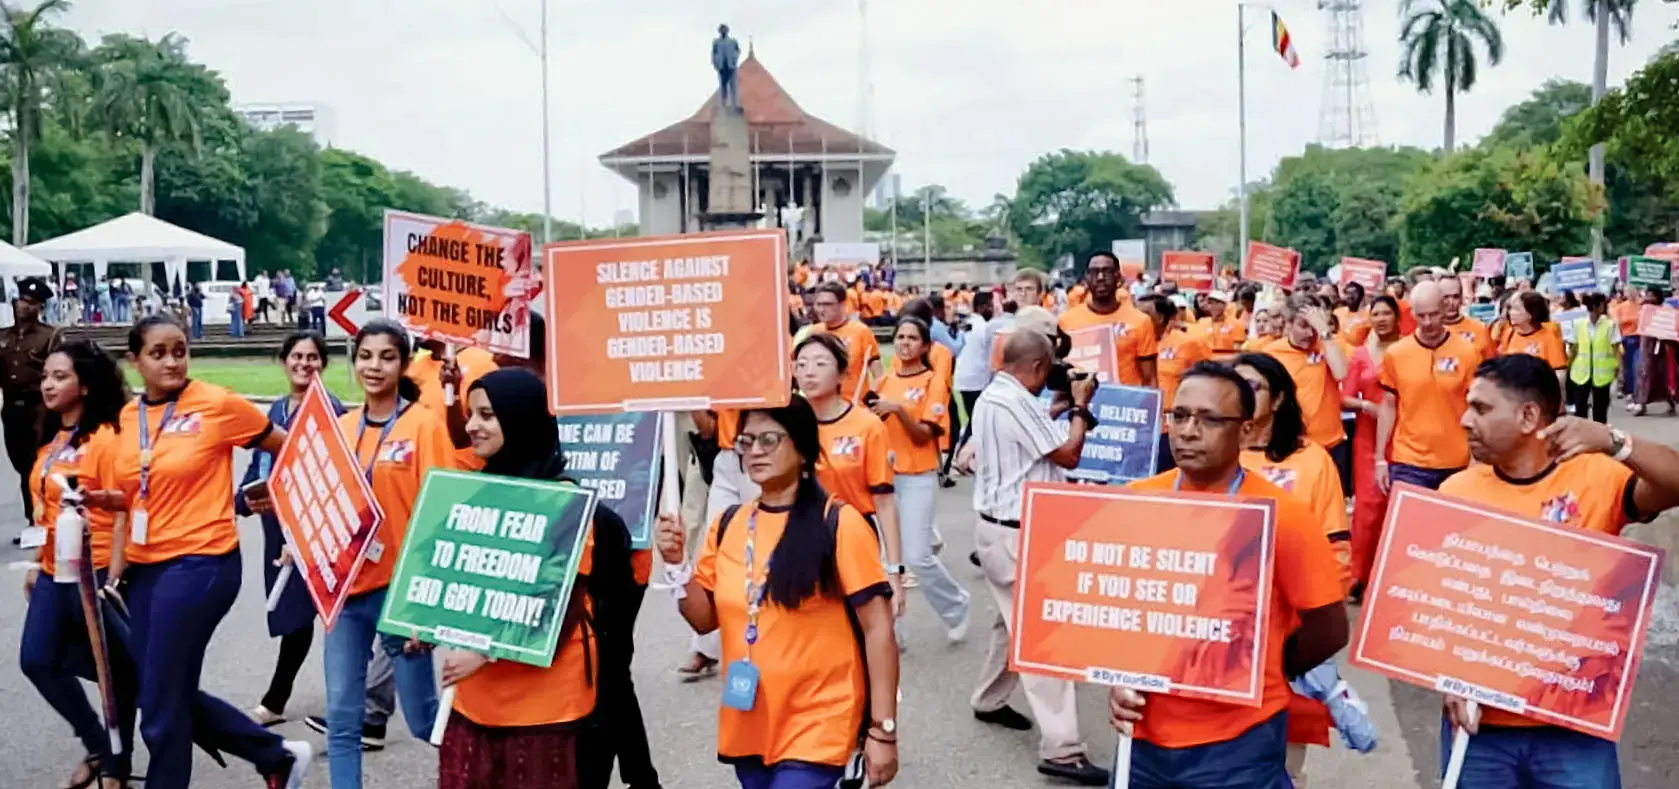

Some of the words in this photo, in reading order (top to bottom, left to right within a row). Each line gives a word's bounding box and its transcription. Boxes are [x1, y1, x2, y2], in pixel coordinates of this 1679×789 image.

[407, 233, 469, 263] CHANGE
[475, 244, 505, 270] THE
[596, 261, 659, 282] SILENCE
[664, 255, 730, 279] AGAINST
[418, 266, 491, 301] CULTURE,
[605, 282, 723, 309] GENDER-BASED
[398, 292, 426, 318] NOT
[432, 299, 461, 325] THE
[465, 306, 513, 334] GIRLS
[618, 309, 692, 333] VIOLENCE
[696, 308, 712, 329] IS
[606, 333, 725, 359] GENDER-BASED
[629, 358, 704, 383] VIOLENCE
[1100, 404, 1148, 424] BELIEVE
[583, 423, 613, 443] CAN
[615, 423, 635, 443] BE
[564, 451, 598, 471] CTIM
[600, 451, 621, 471] OF
[447, 503, 499, 537] FROM
[500, 510, 549, 544] FEAR
[431, 539, 457, 569] TO
[454, 543, 543, 584] FREEDOM
[1064, 539, 1087, 562] DO
[1092, 542, 1126, 567] NOT
[1129, 546, 1152, 570] BE
[1156, 548, 1218, 577] SILENT
[406, 575, 443, 607] END
[443, 582, 482, 615] GBV
[481, 589, 547, 627] TODAY!
[1077, 571, 1095, 594] IF
[1097, 573, 1132, 598] YOU
[1135, 577, 1169, 604] SEE
[1172, 581, 1198, 606] OR
[1042, 599, 1142, 633] EXPERIENCE
[1146, 611, 1234, 643] VIOLENCE
